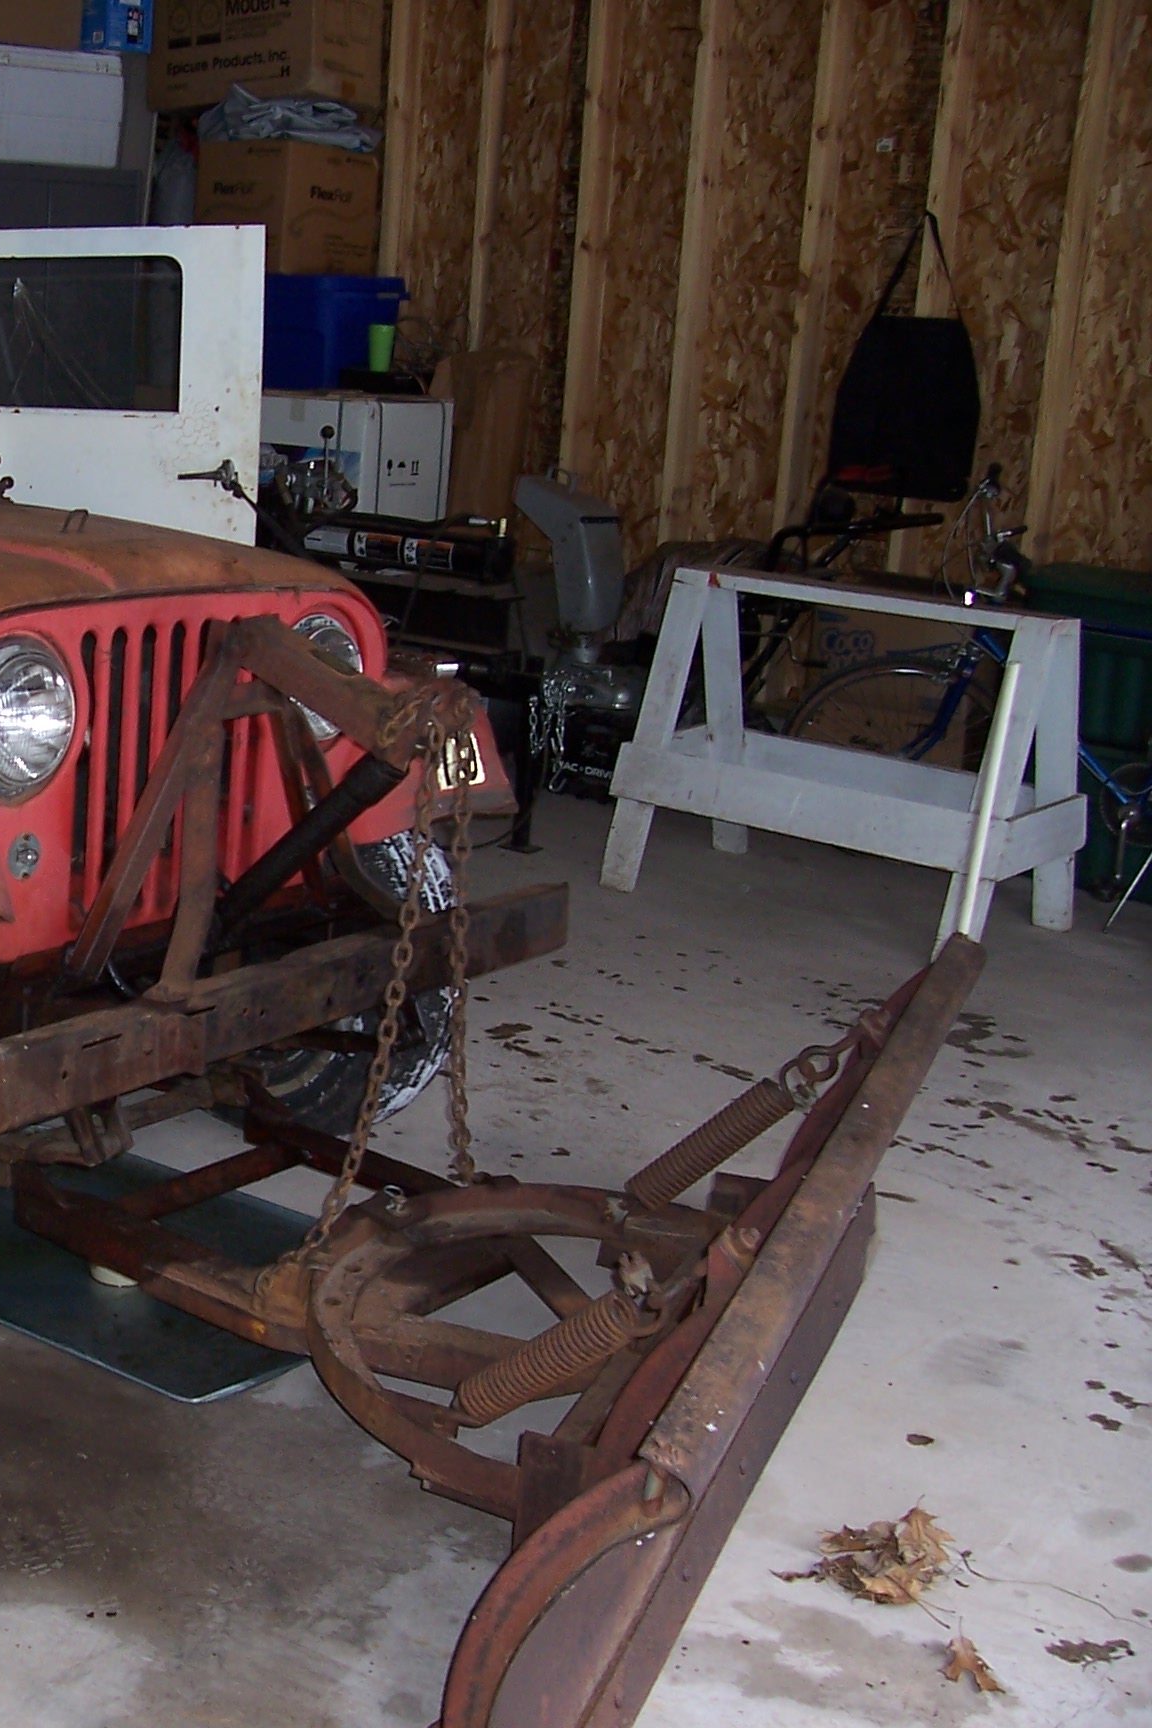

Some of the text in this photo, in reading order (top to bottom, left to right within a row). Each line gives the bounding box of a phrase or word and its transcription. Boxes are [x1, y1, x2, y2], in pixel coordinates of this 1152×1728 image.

[167, 61, 209, 76] Epicure
[269, 50, 291, 62] Inc.
[280, 65, 290, 77] H
